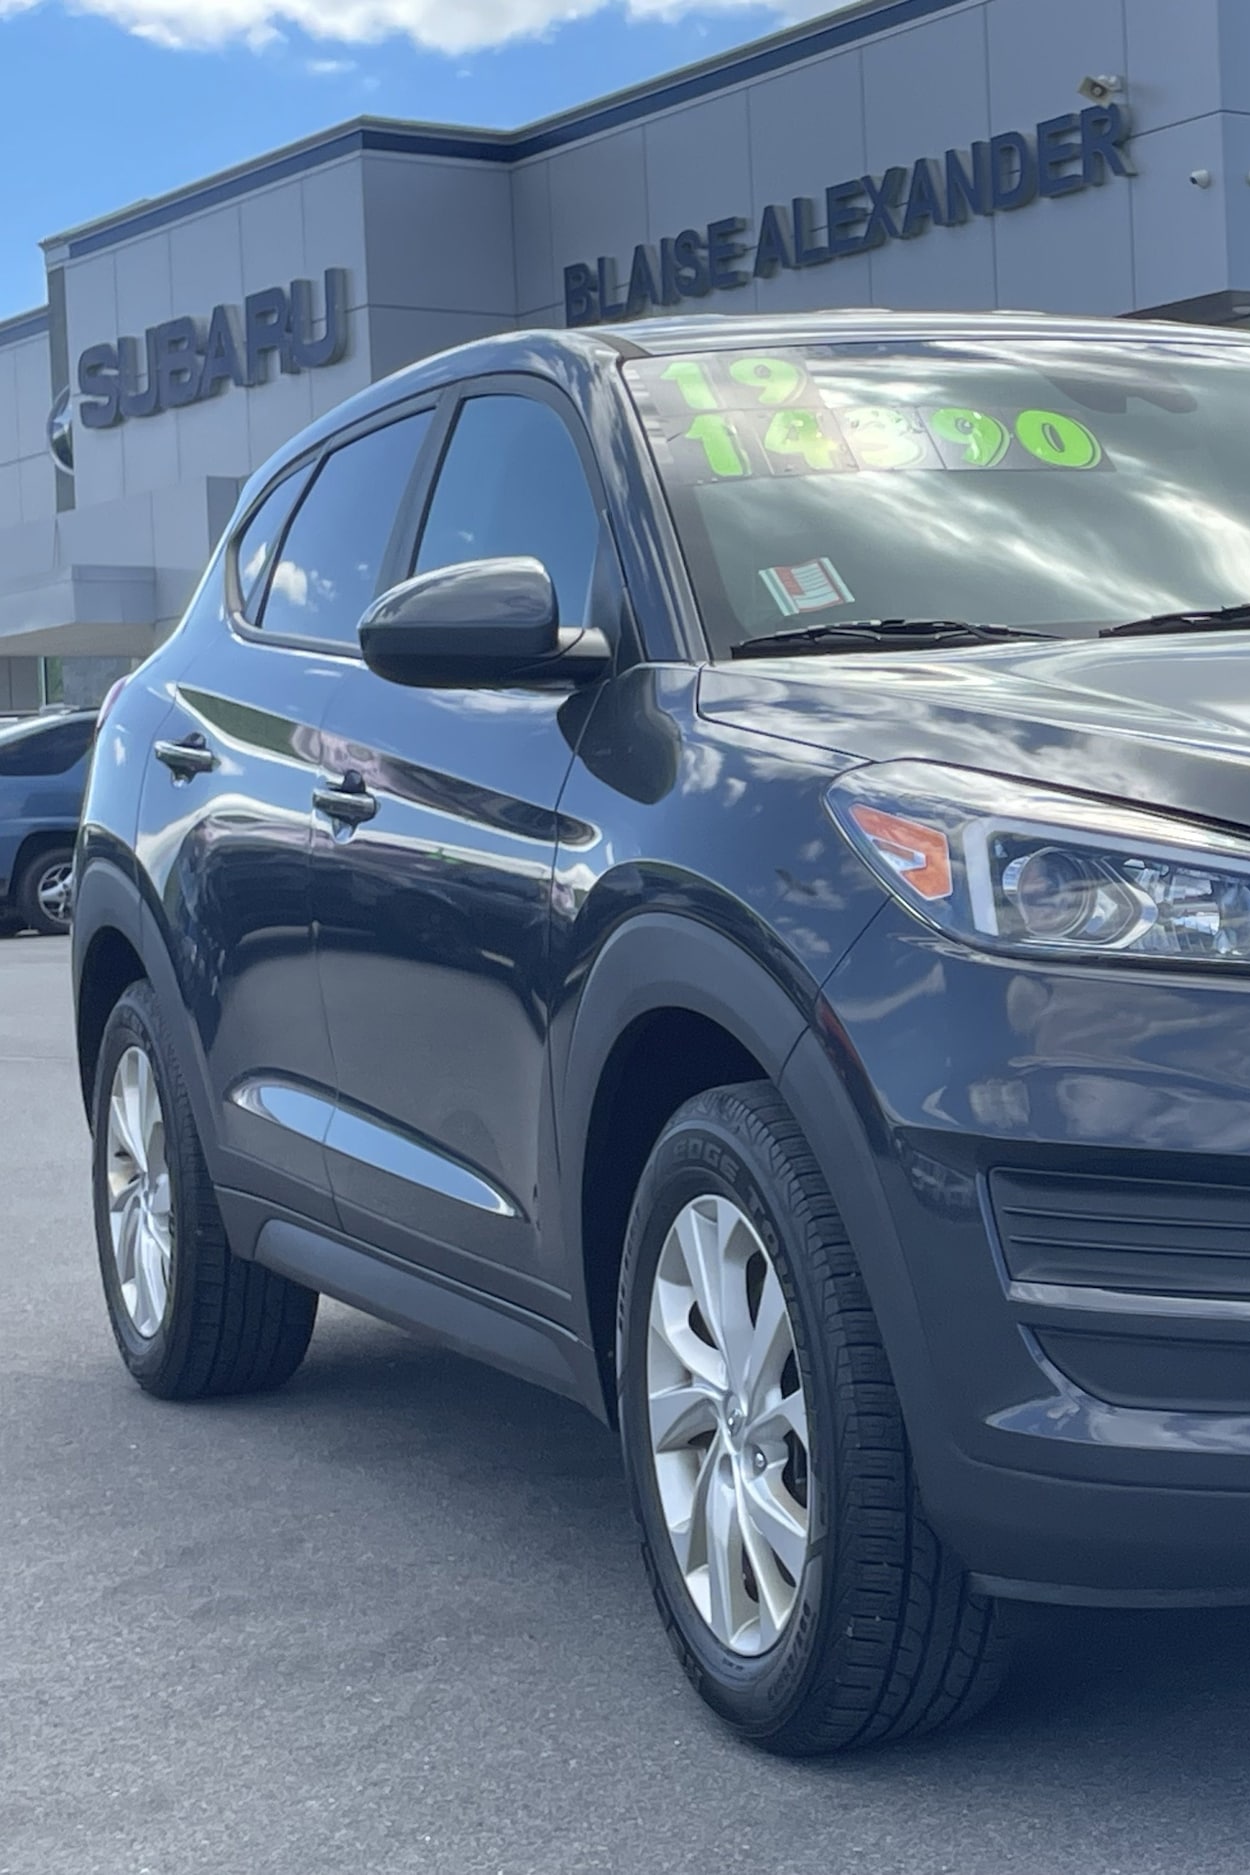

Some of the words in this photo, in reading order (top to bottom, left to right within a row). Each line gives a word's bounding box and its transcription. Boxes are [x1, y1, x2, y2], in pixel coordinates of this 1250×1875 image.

[563, 216, 750, 328] BLAISE
[752, 101, 1138, 280] ALEXANDER
[77, 266, 348, 430] SUBARU
[660, 356, 806, 410] 19
